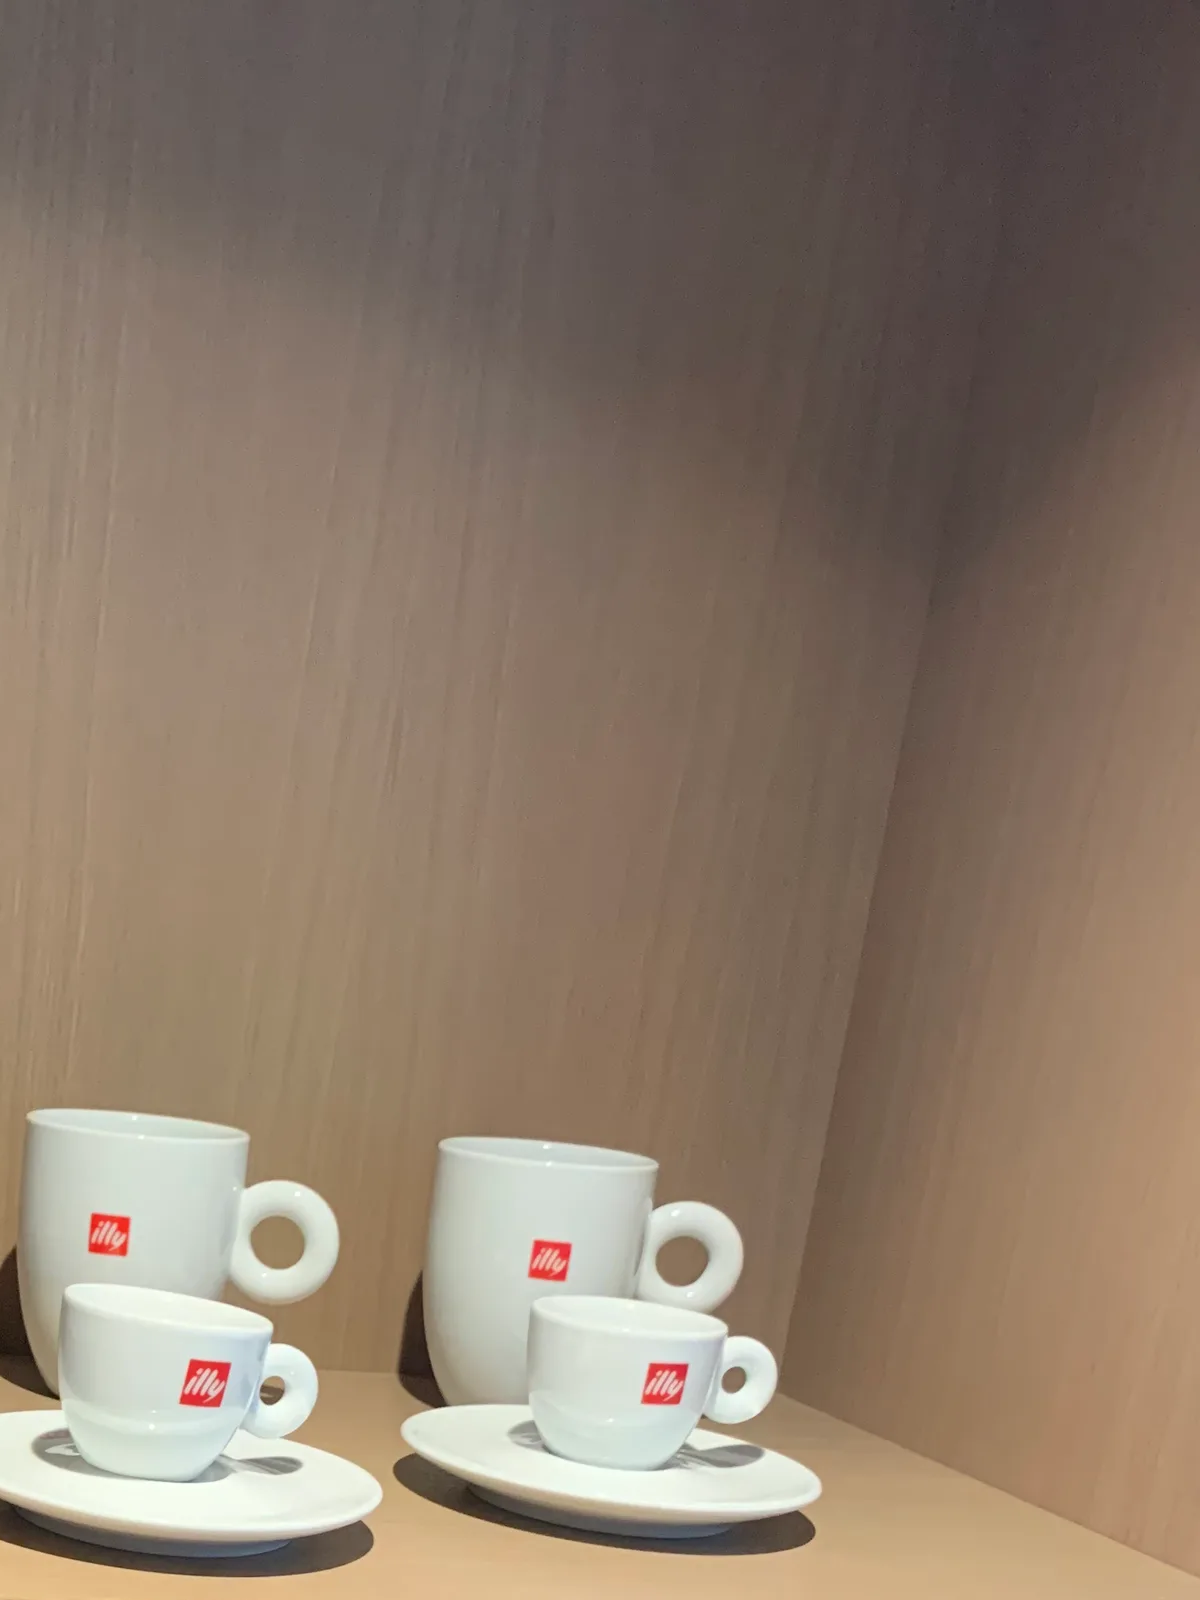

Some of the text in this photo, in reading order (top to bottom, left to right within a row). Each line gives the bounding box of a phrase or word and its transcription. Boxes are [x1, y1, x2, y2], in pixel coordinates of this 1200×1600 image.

[91, 1220, 127, 1251] illy
[532, 1248, 566, 1277] illy
[184, 1368, 225, 1404] illy
[644, 1370, 683, 1401] illy
